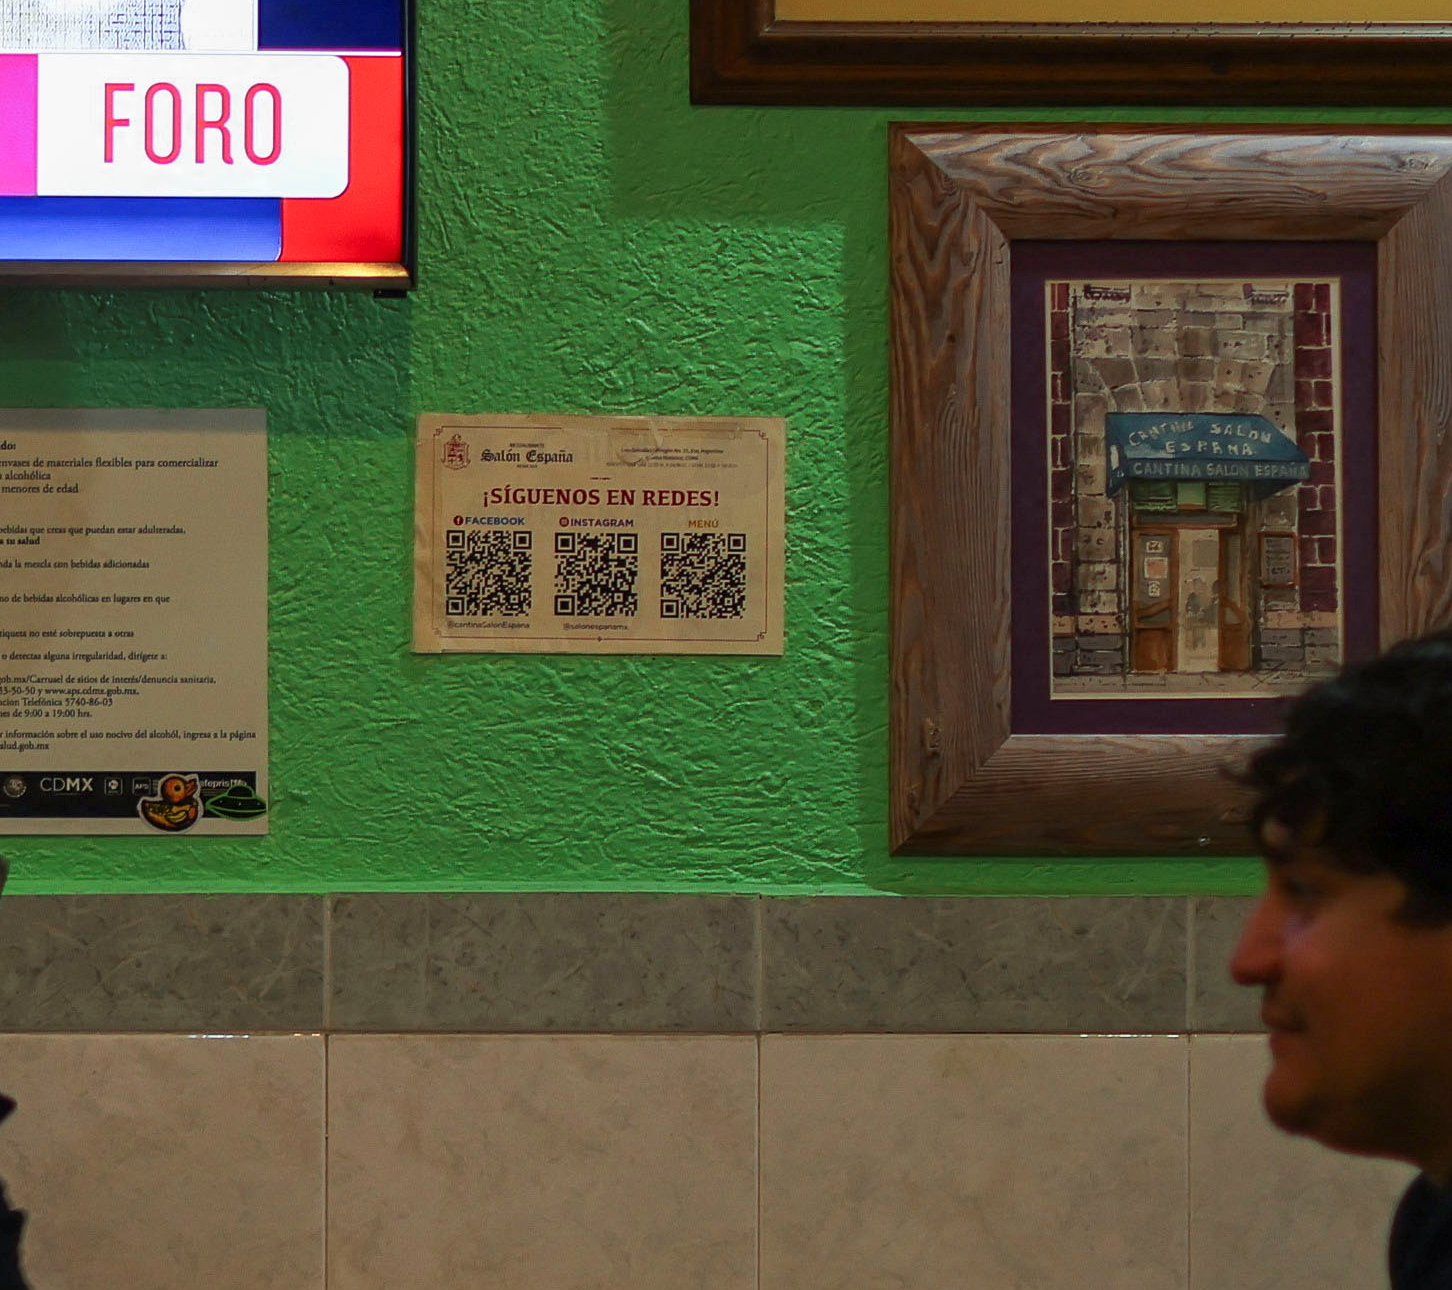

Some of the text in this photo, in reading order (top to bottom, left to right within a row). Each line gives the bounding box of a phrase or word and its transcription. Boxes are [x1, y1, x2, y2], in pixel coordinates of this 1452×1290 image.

[104, 82, 282, 165] FORO
[32, 456, 45, 468] de
[46, 457, 93, 469] materiales
[95, 456, 133, 468] flexibles
[135, 460, 155, 471] para
[157, 456, 219, 468] comercializar
[1133, 461, 1202, 478] CANTINA
[4, 469, 52, 481] alcohólica
[1, 486, 41, 494] menores
[42, 483, 54, 494] de
[56, 482, 79, 494] edad
[484, 485, 718, 507] ¡SÍGUENOS EN REDES!
[464, 516, 525, 526] FACEBOOK
[570, 518, 634, 528] INSTAGRAM
[687, 519, 720, 529] MENÚ
[30, 527, 45, 538] que
[69, 527, 84, 538] que
[85, 525, 115, 538] puedan
[16, 535, 41, 545] salud
[39, 776, 94, 792] CDMX
